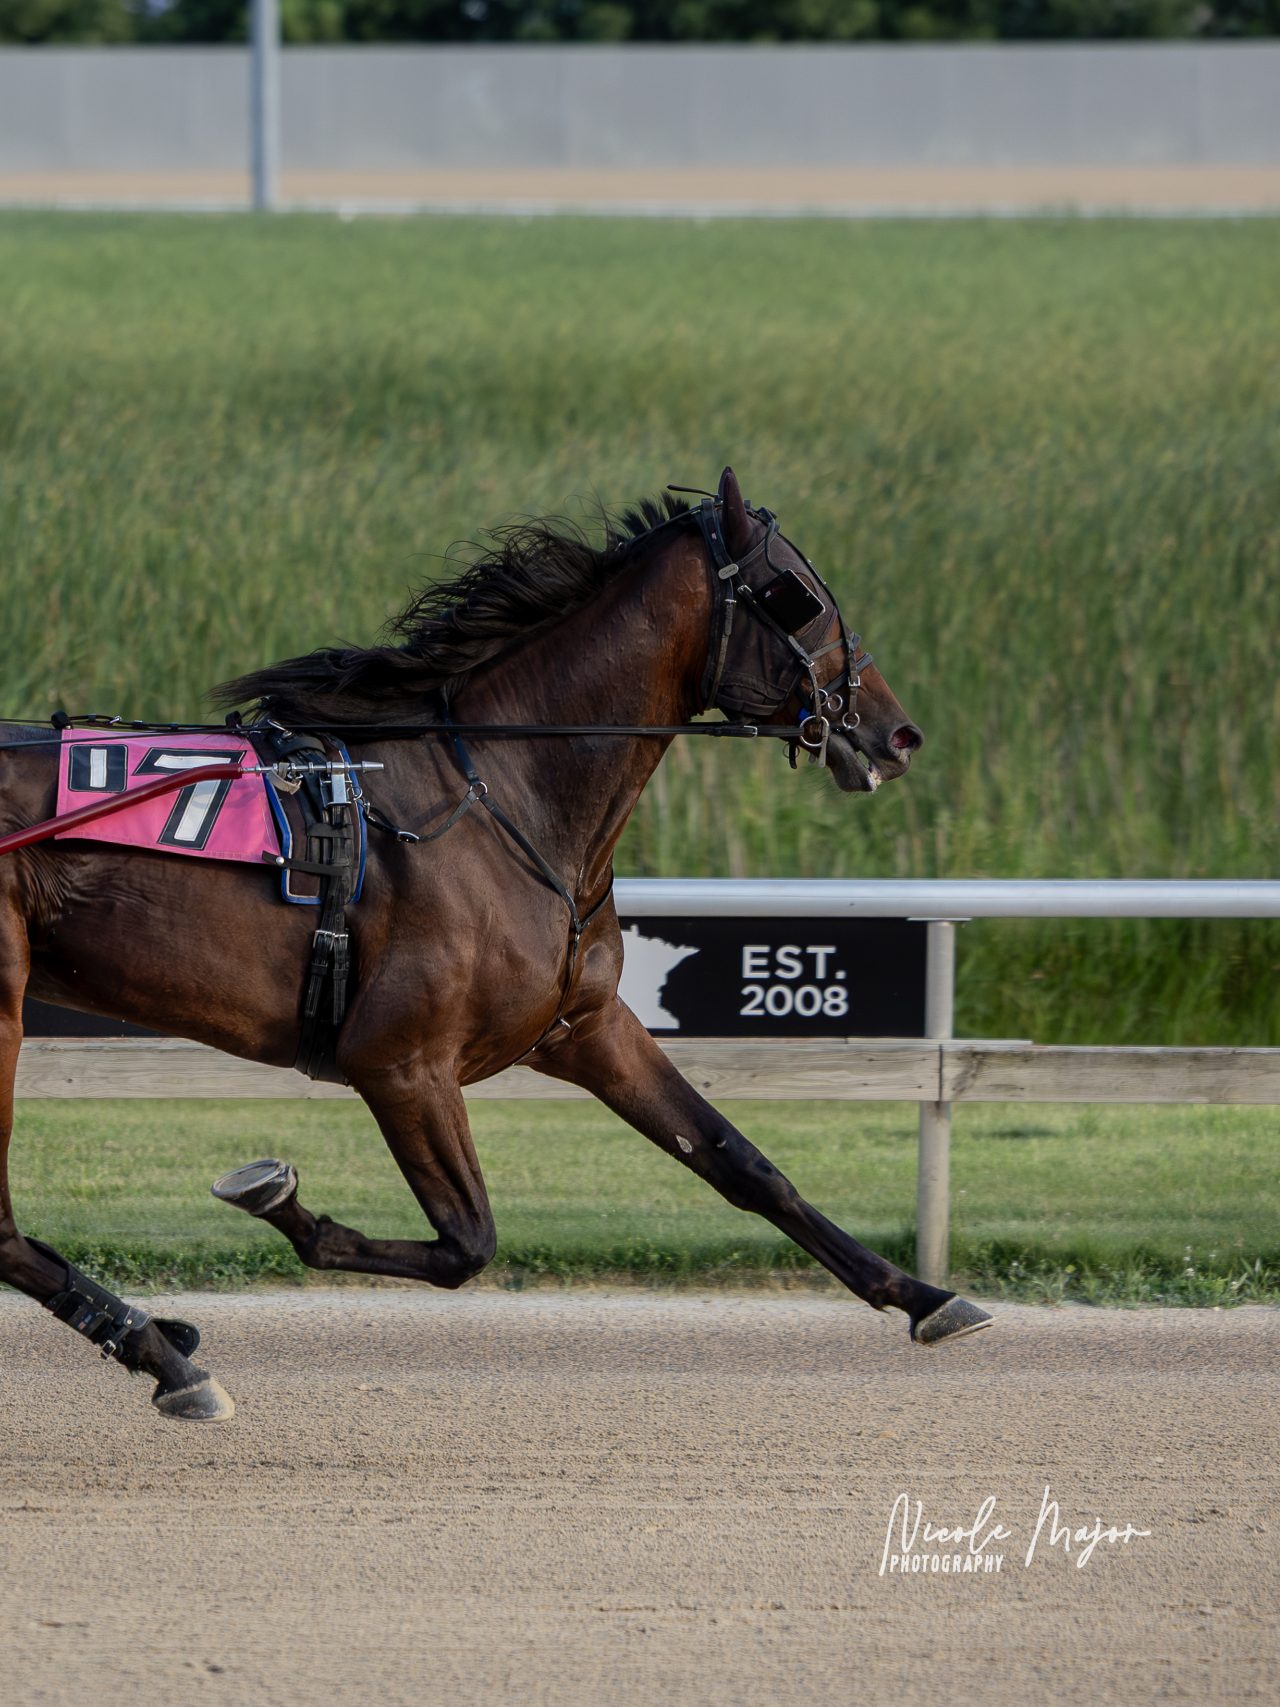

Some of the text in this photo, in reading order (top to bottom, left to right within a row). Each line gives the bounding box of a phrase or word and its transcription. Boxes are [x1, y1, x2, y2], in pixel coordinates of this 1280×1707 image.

[145, 750, 238, 846] 7
[742, 945, 847, 980] EST.
[739, 984, 849, 1017] 2008
